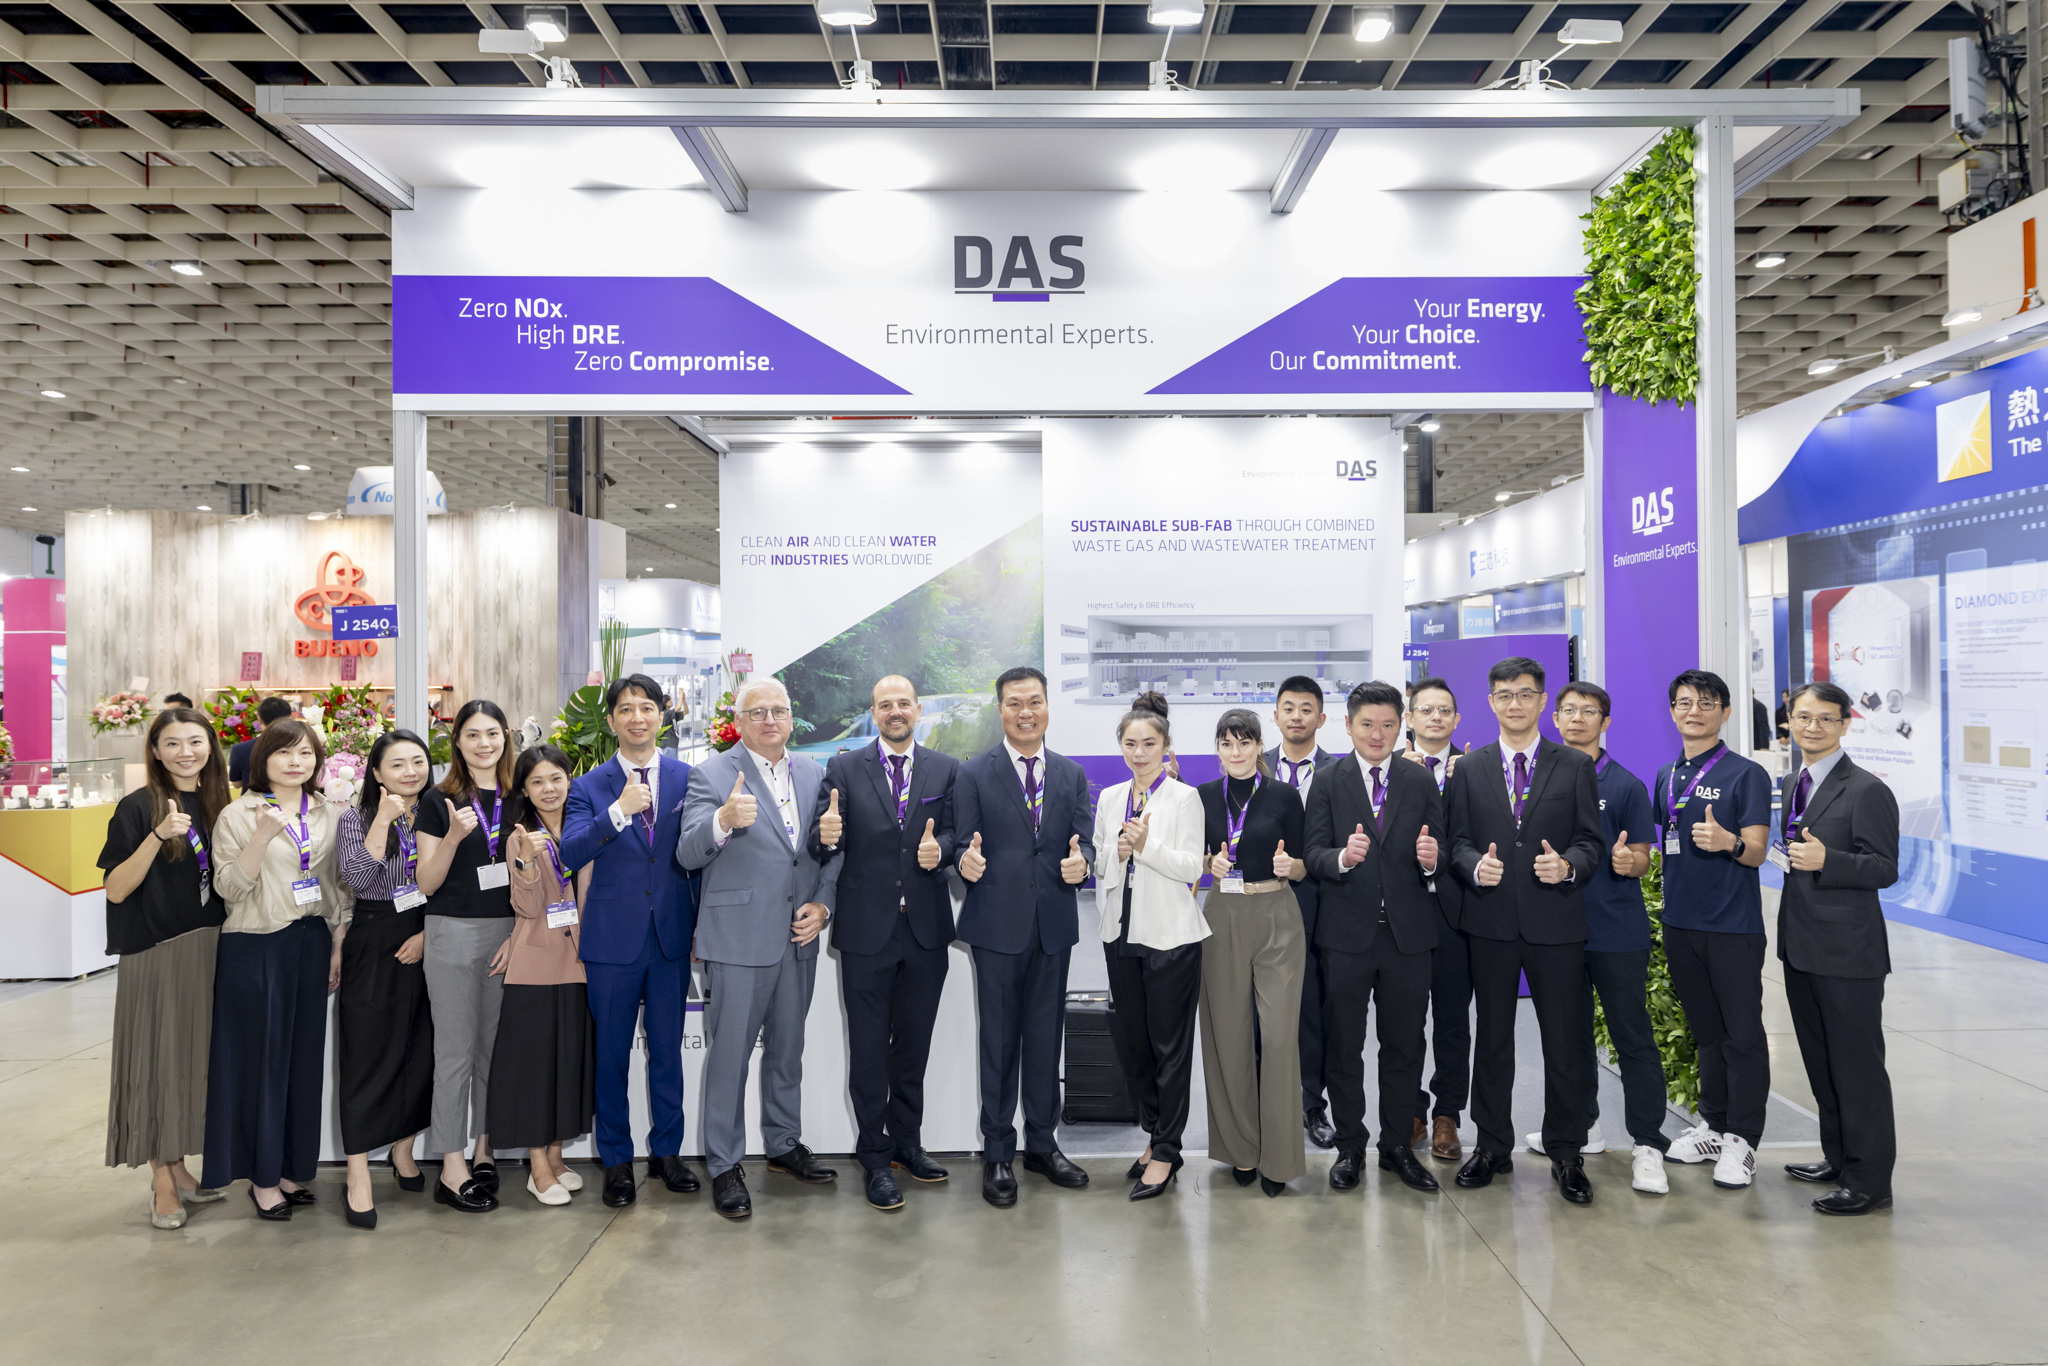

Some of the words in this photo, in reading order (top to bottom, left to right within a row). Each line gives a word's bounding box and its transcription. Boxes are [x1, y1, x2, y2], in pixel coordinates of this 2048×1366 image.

[954, 236, 1085, 289] DAS
[458, 297, 508, 319] Zero
[514, 297, 568, 319] NOx.
[1413, 298, 1462, 319] Your
[1467, 298, 1546, 323] Energy.
[517, 324, 565, 350] High
[572, 324, 625, 345] DRE.
[886, 323, 1054, 345] Environmental
[1062, 323, 1154, 350] Experts.
[1351, 324, 1400, 345] Your
[1405, 324, 1480, 345] Choice.
[574, 350, 623, 371] Zero
[629, 350, 775, 376] Compromise.
[1269, 350, 1307, 371] Our
[1312, 350, 1461, 371] Commitment.
[2008, 386, 2048, 431] 熱
[2008, 436, 2042, 457] The
[1336, 460, 1377, 477] DAS
[1631, 486, 1675, 532] DAS
[1070, 519, 1168, 533] SUSTAINABLE
[1171, 519, 1233, 532] SUB-FAB
[1235, 518, 1302, 532] THROUGH
[1305, 518, 1375, 532] COMBINED
[740, 536, 783, 548] CLEAN
[786, 535, 809, 547] AIR
[813, 535, 841, 547] AND
[844, 535, 886, 547] CLEAN
[889, 535, 937, 547] WATER
[1072, 539, 1122, 552] WASTE
[1125, 539, 1154, 552] GAS
[1157, 538, 1187, 552] AND
[1190, 538, 1289, 552] WASTEWATER
[1293, 538, 1377, 551] TREATMENT
[741, 554, 767, 566] FOR
[770, 554, 849, 566] INDUSTRIES
[852, 553, 933, 565] WORLDWIDE
[1613, 547, 1664, 568] Environmental
[1665, 540, 1698, 559] Experts.
[1087, 602, 1114, 611] Highest
[1115, 602, 1138, 610] Safety
[1139, 602, 1145, 610] &
[1161, 602, 1195, 610] Efficiency
[1955, 591, 2018, 610] DIAMOND
[340, 620, 348, 631] J
[352, 618, 390, 631] 2540
[294, 639, 378, 658] BUENO
[1694, 785, 1721, 800] DAS
